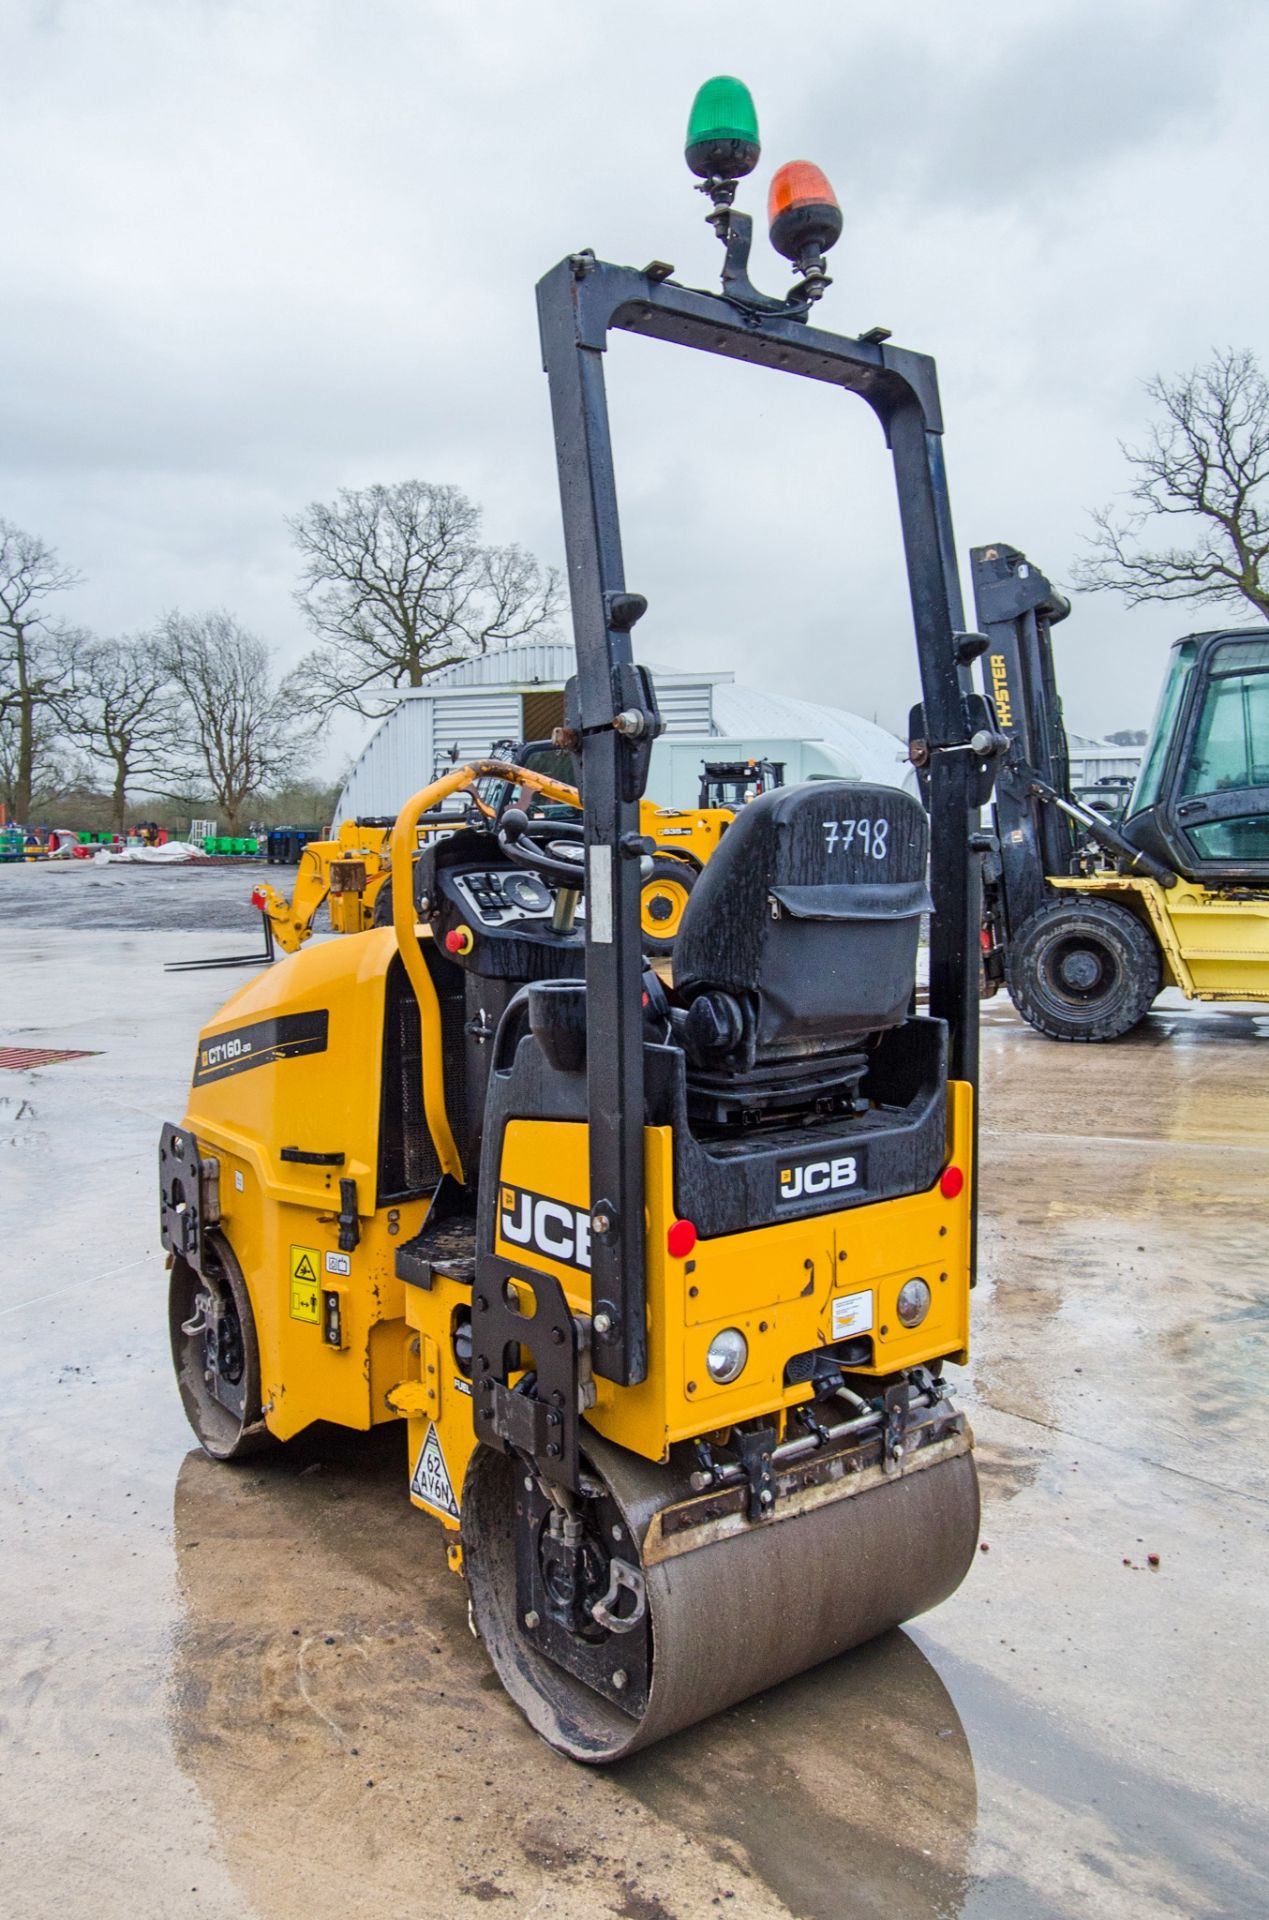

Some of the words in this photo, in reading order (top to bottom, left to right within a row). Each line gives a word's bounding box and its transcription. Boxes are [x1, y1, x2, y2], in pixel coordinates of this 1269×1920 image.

[990, 655, 1013, 727] HYSTER
[822, 818, 889, 860] 7798
[780, 1156, 857, 1199] JCB
[454, 1379, 471, 1395] FUEL
[426, 1454, 441, 1478] 62
